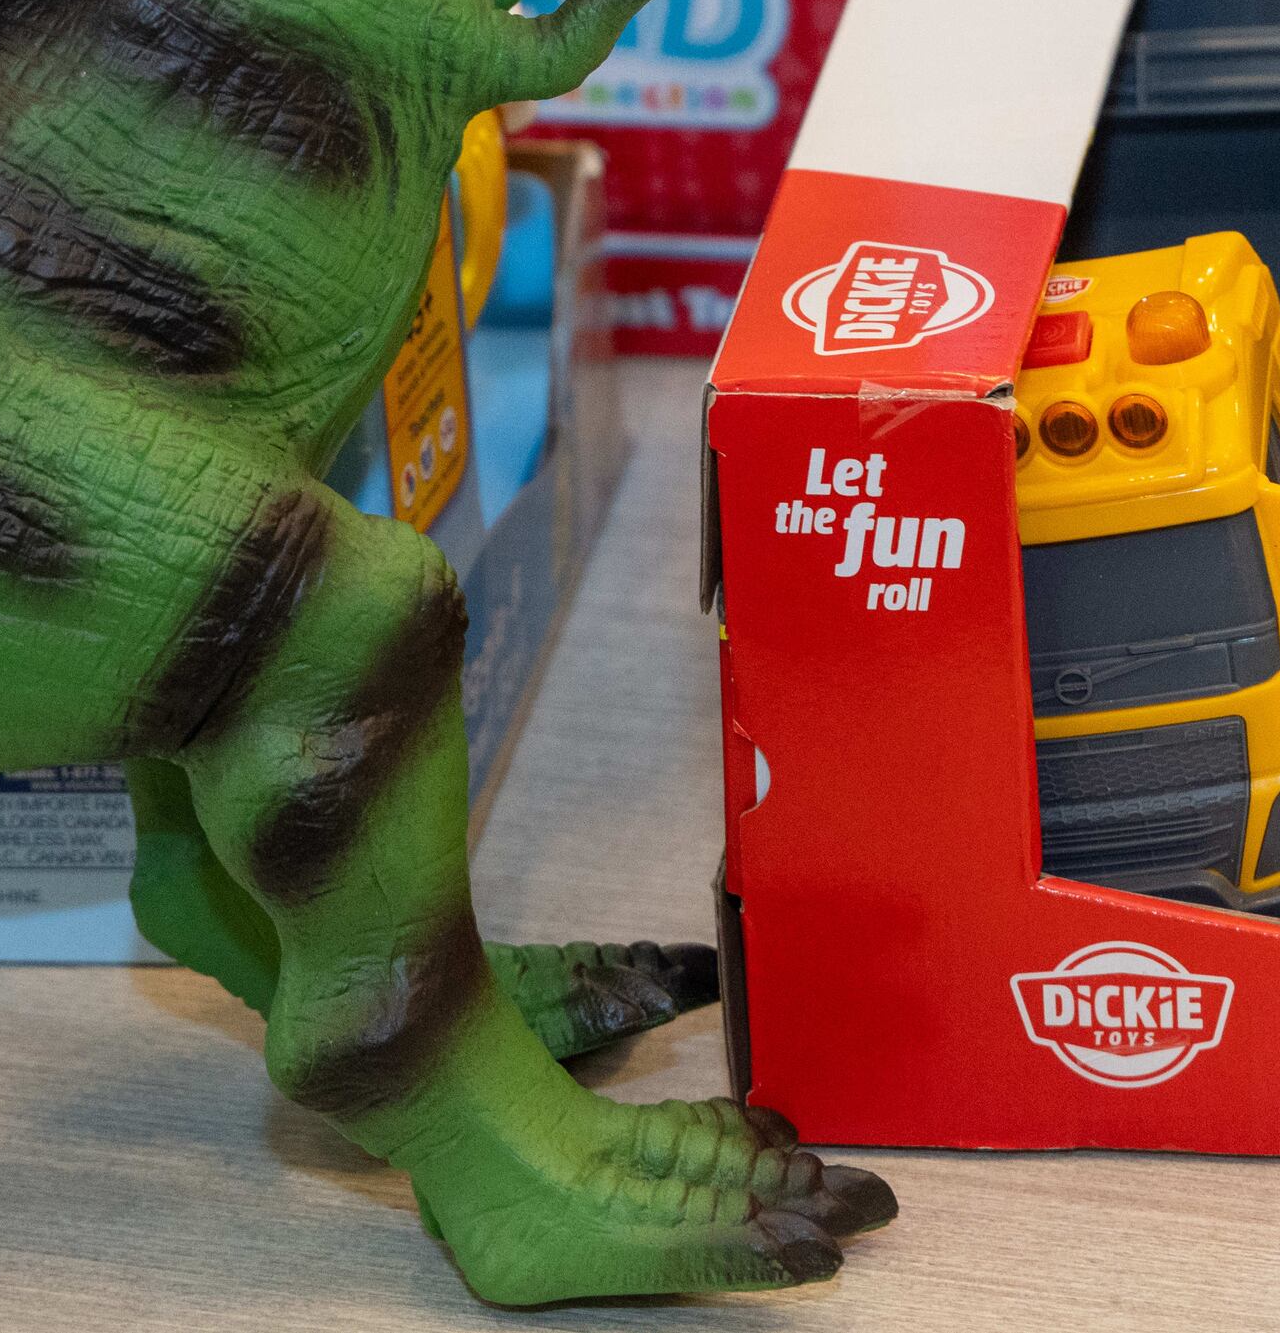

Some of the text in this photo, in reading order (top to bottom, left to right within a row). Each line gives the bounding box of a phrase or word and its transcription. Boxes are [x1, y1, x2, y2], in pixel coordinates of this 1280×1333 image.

[907, 282, 937, 315] TOYS
[805, 448, 888, 498] Let
[775, 500, 966, 577] the fun
[866, 578, 933, 612] roll
[1093, 1030, 1155, 1047] TOYS
